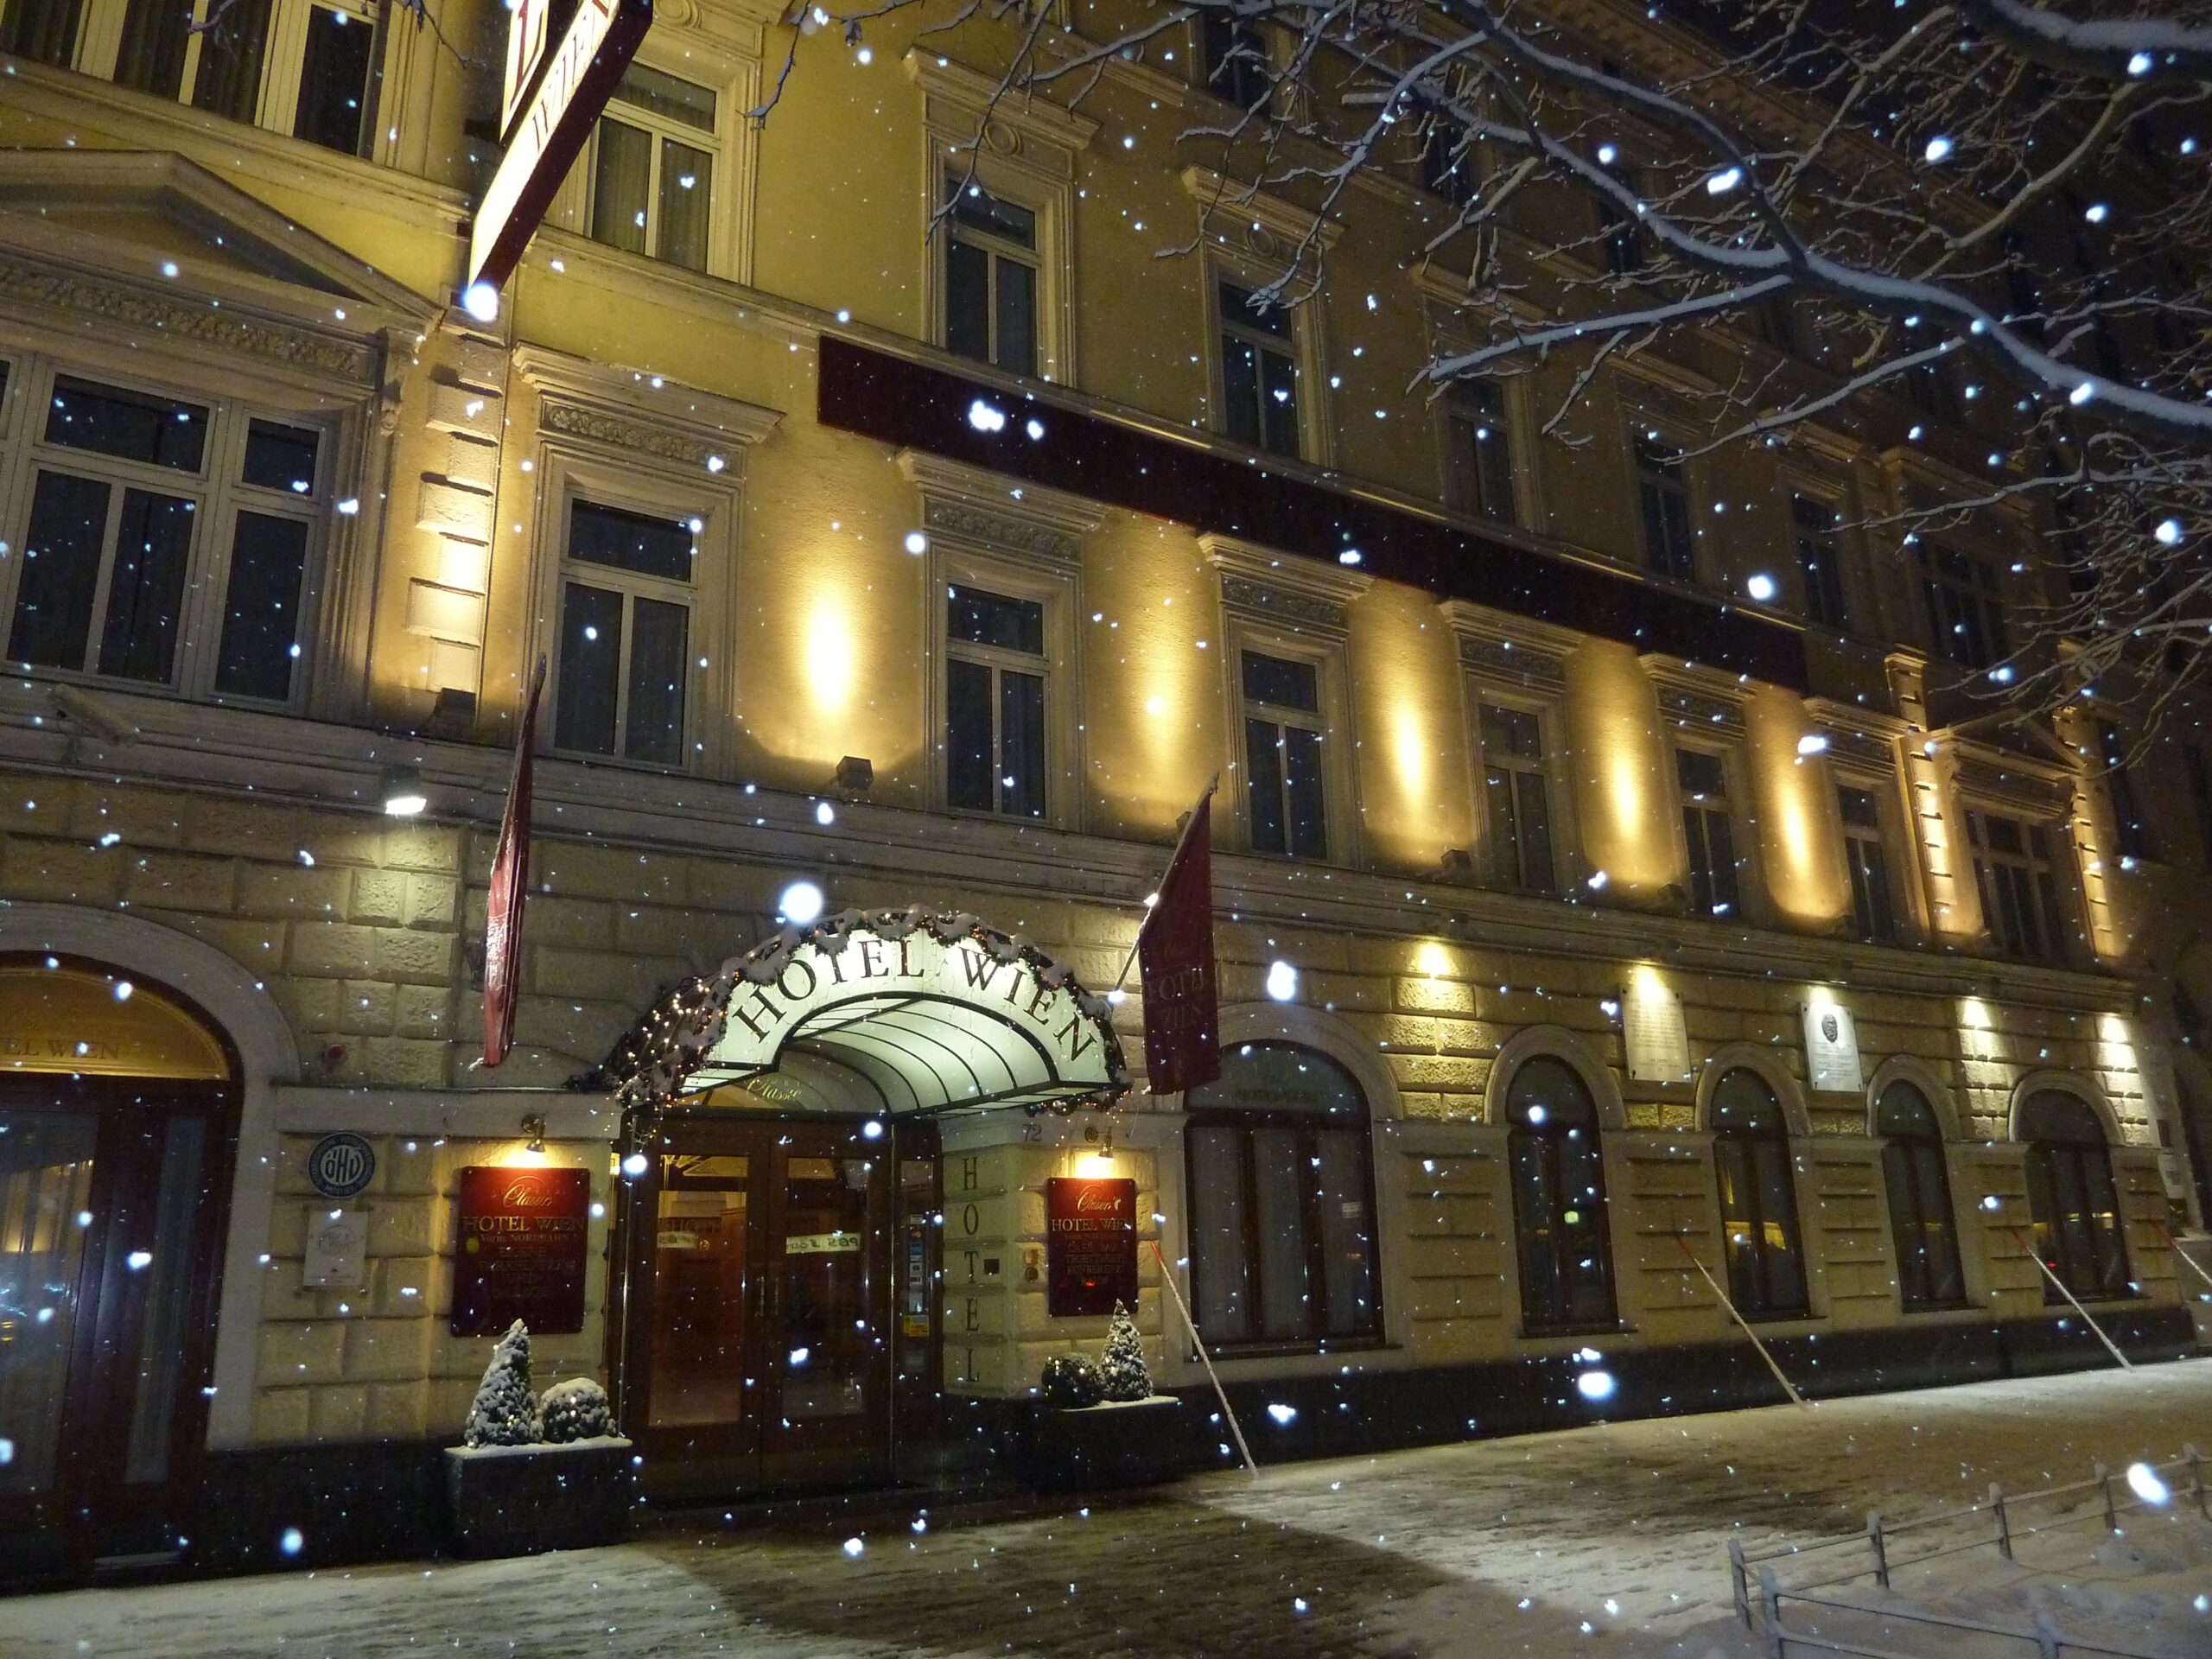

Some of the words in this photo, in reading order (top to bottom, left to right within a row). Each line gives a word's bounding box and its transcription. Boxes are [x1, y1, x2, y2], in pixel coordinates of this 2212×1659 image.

[732, 938, 925, 1044] HOTEL
[958, 945, 1096, 1063] WIEN
[1024, 1124, 1042, 1141] 72
[461, 1216, 530, 1232] HOTEL
[534, 1216, 586, 1232] WIEN
[1051, 1218, 1097, 1232] HOTEL
